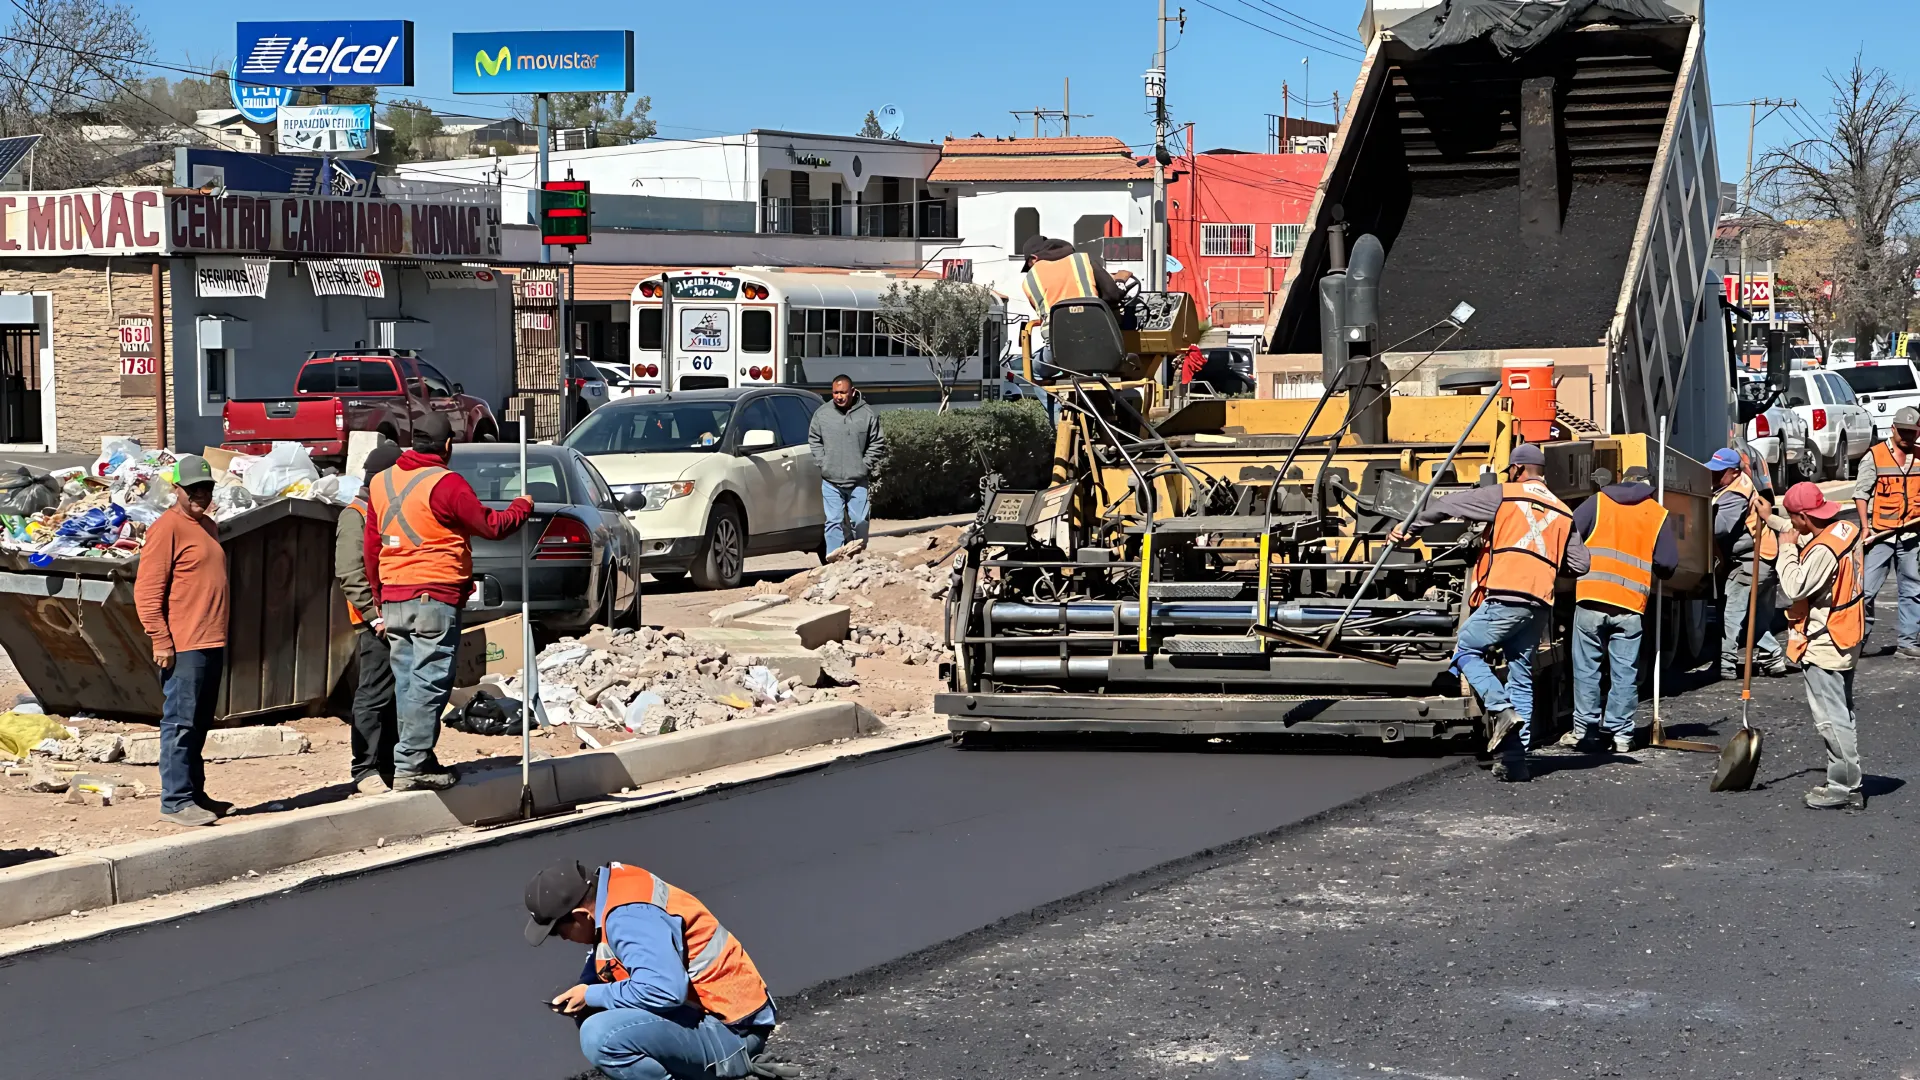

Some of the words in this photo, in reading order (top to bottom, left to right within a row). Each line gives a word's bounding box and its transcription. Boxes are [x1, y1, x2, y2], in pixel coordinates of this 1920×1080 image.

[284, 36, 399, 74] telcel
[517, 52, 599, 70] movistar
[28, 191, 159, 251] MONAC
[171, 195, 271, 249] CENTRO
[282, 198, 404, 254] CAMBIARIO
[411, 204, 480, 254] MONAC
[200, 269, 249, 284] SEGUROS
[316, 269, 361, 286] PESOS
[425, 270, 476, 280] DOLARES
[119, 326, 150, 343] 1630
[120, 358, 156, 374] 1730
[692, 356, 713, 371] 60
